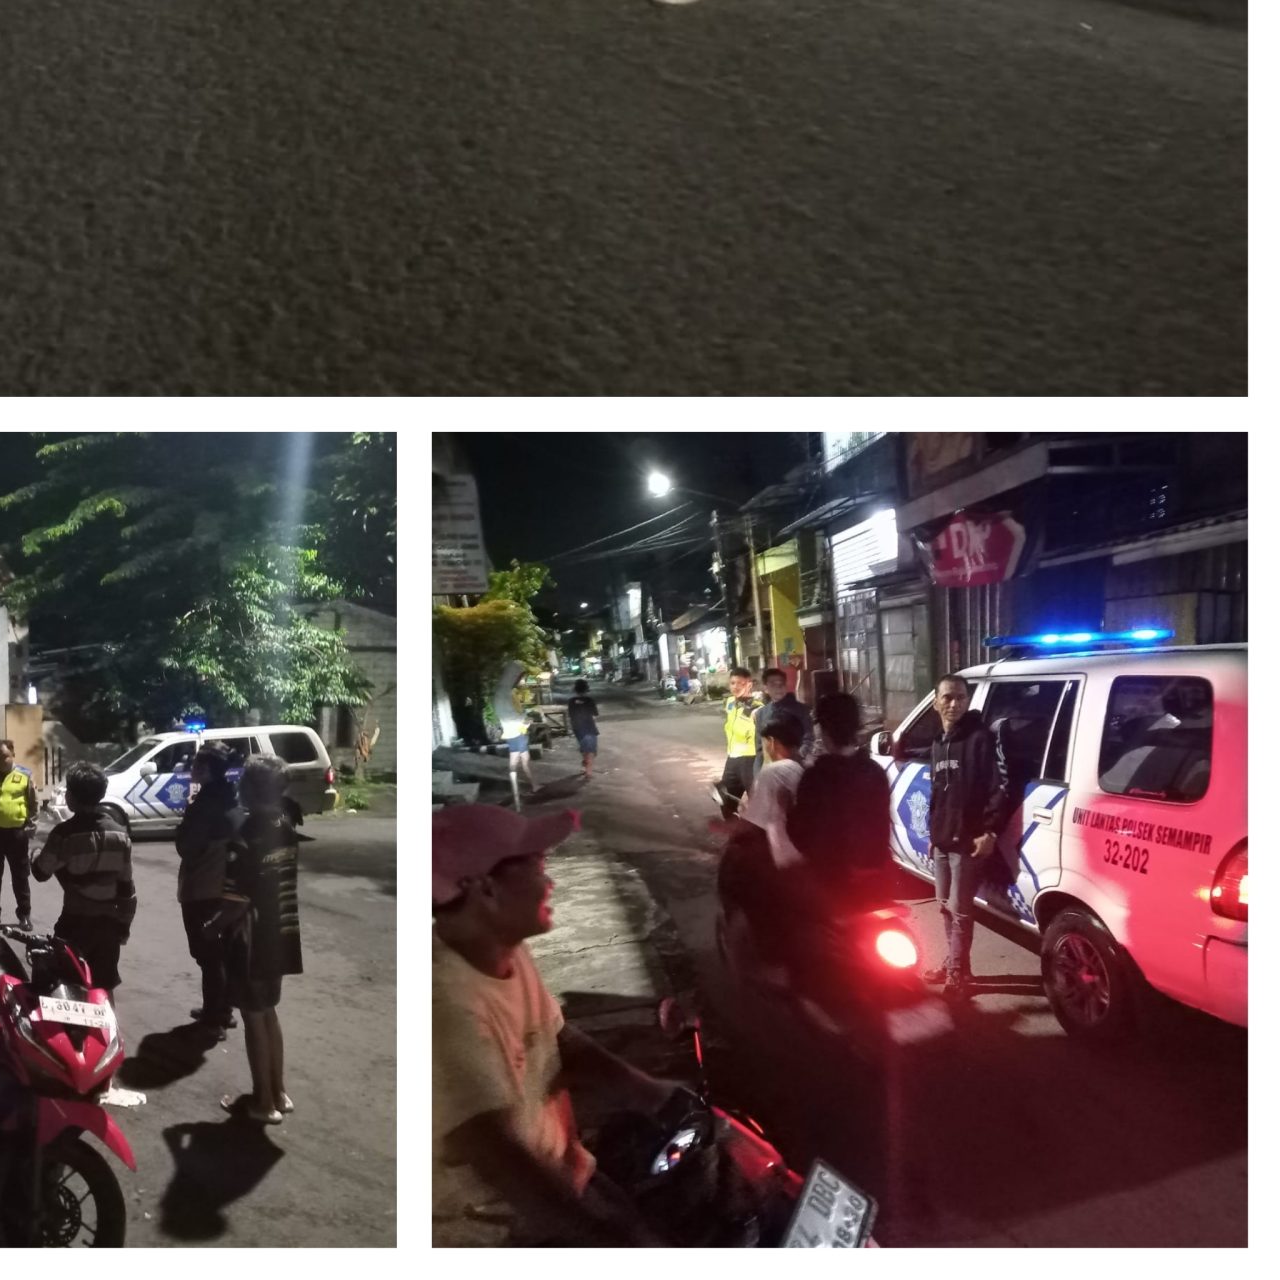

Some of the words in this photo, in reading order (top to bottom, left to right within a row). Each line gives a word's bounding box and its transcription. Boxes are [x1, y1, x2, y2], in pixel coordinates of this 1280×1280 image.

[1072, 806, 1091, 826] UNIT
[1090, 811, 1121, 834] LANTAS
[1120, 818, 1157, 842] POLSEK
[1155, 824, 1213, 855] SEMAMPIR
[1103, 838, 1150, 875] 32-202
[807, 1170, 841, 1221] DBC
